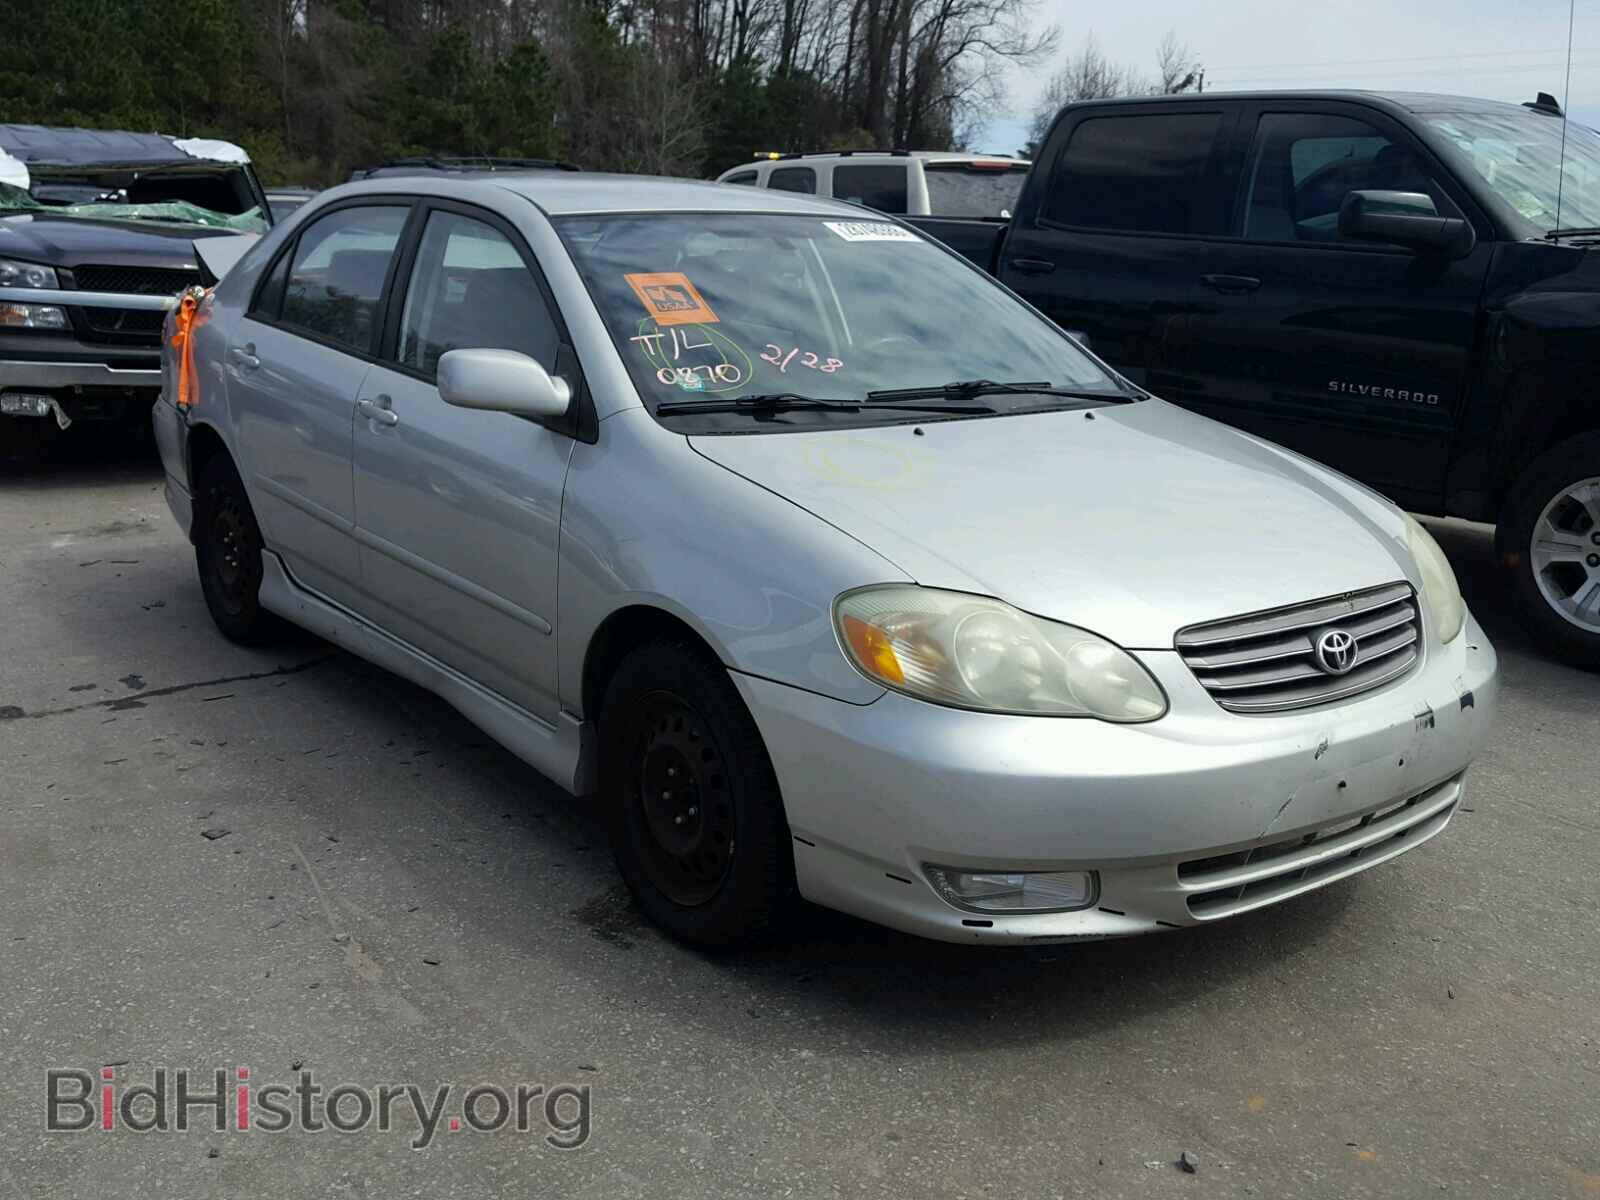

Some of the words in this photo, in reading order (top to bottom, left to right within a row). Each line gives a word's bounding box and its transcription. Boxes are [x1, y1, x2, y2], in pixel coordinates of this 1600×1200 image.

[760, 343, 844, 373] 2/28
[656, 364, 741, 388] 0870
[1328, 381, 1439, 405] SILVERADO
